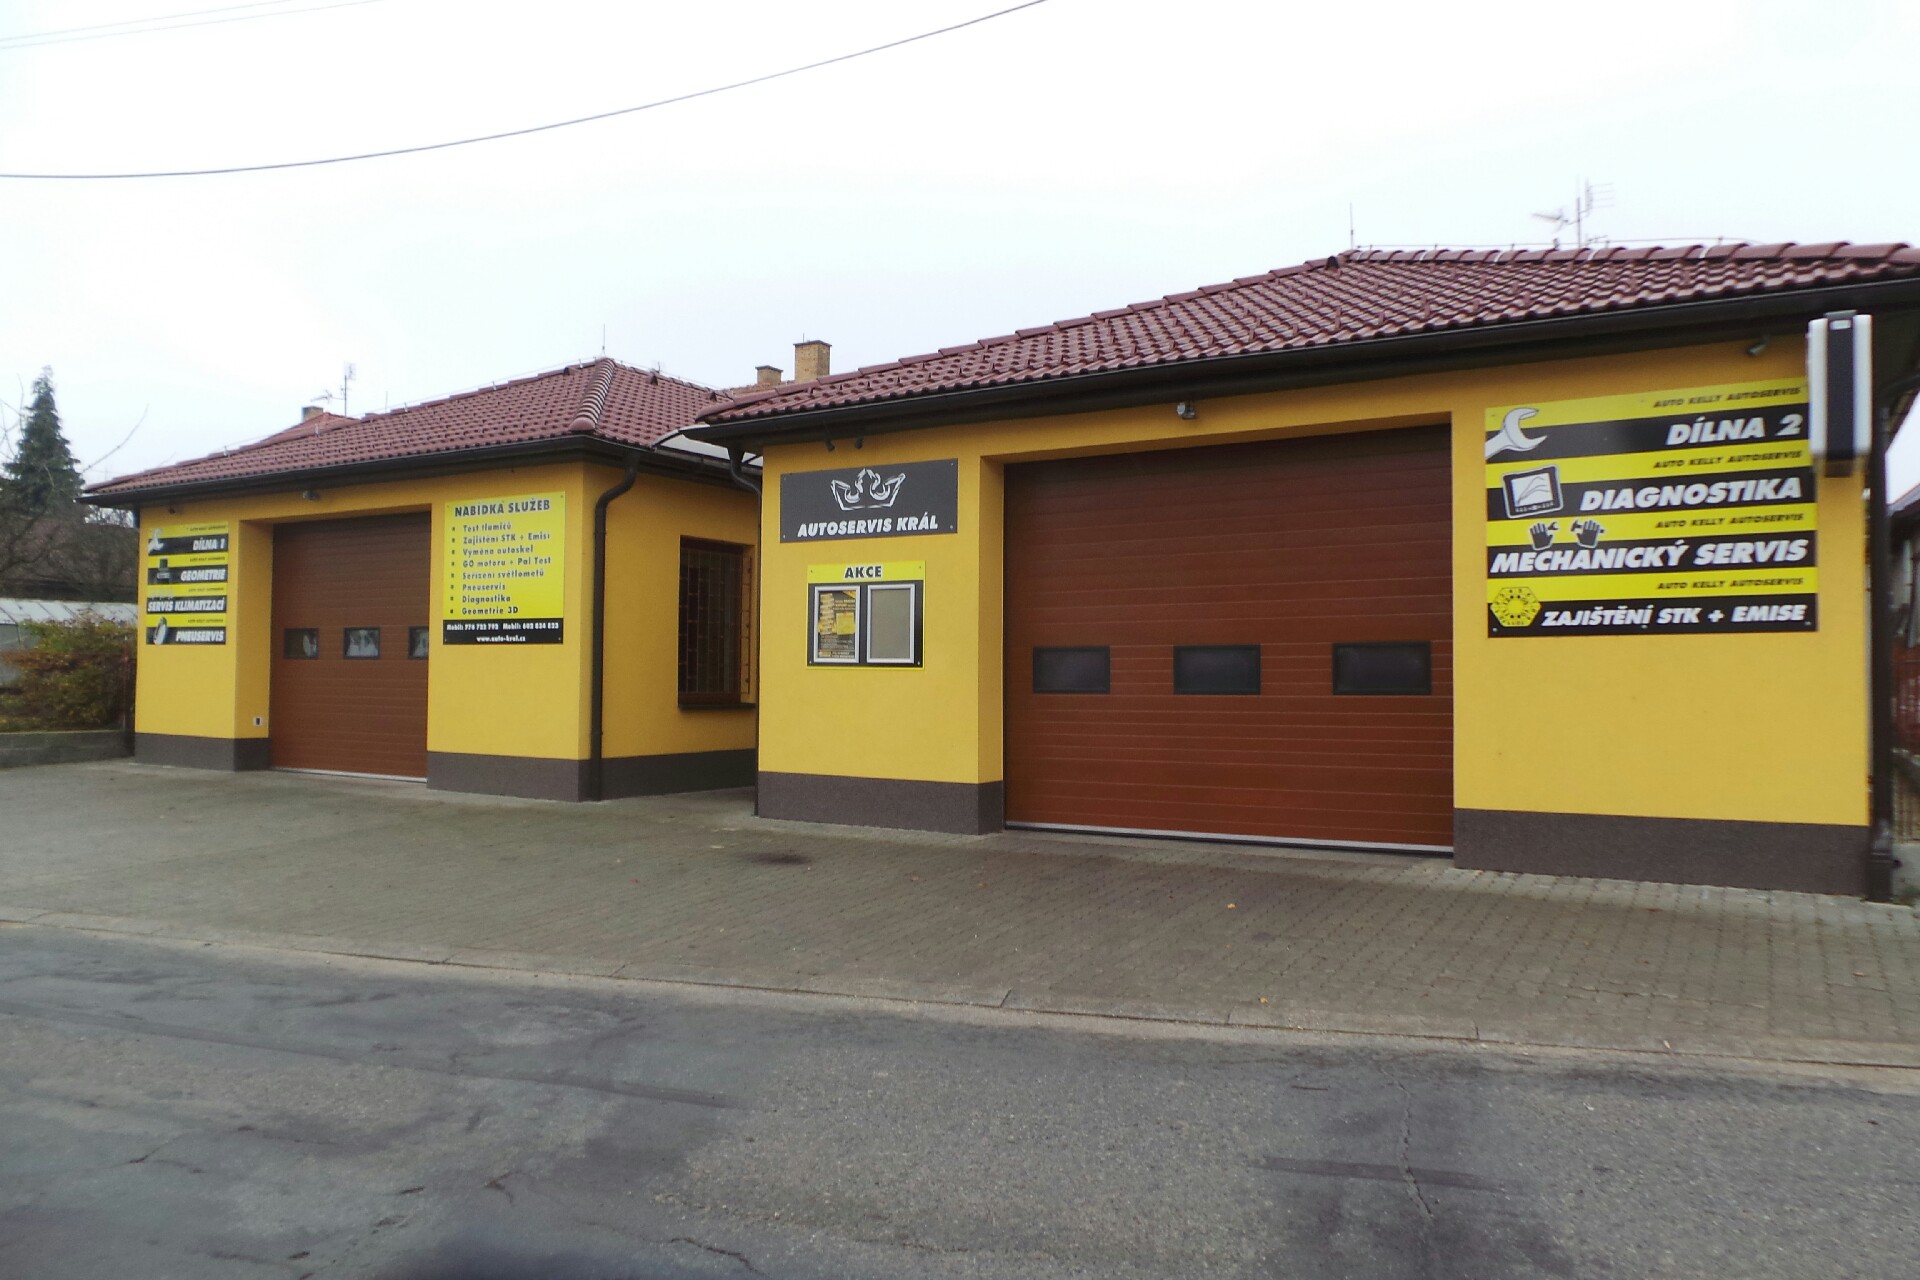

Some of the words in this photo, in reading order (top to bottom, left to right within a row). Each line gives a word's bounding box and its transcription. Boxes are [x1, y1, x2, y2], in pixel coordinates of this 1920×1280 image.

[1665, 416, 1765, 445] DÍLNA
[1775, 413, 1803, 436] 2
[1580, 477, 1801, 512] DIAGNOSTIKA
[508, 498, 550, 513] SLUŽEB
[463, 524, 479, 532] Test
[797, 517, 892, 538] AUTOSERVIS
[897, 511, 938, 532] KRÁL
[1655, 519, 1687, 529] AUTO
[192, 537, 218, 551] DÍLNA
[220, 538, 226, 549] 1
[501, 533, 516, 542] STK
[497, 544, 533, 555] autoskel
[477, 559, 505, 567] motoru
[534, 556, 551, 564] Test
[1489, 540, 1689, 574] MECHANICKÝ
[1693, 539, 1808, 566] SERVIS
[181, 569, 226, 582] GEOMETRIE
[844, 565, 883, 579] AKCE
[462, 582, 506, 591] Pneuservis
[1656, 581, 1688, 590] AUTO
[147, 600, 174, 613] SERVIS
[174, 597, 225, 612] KLIMATIZACÍ
[462, 594, 511, 605] Diagnostika
[462, 606, 504, 615] Geometrie
[508, 606, 519, 614] 3D
[1541, 604, 1654, 627] ZAJIŠTĚNÍ
[1656, 608, 1703, 625] STK
[1708, 609, 1724, 623] +
[1730, 604, 1807, 623] EMISE
[176, 630, 224, 643] PNEUSERVIS
